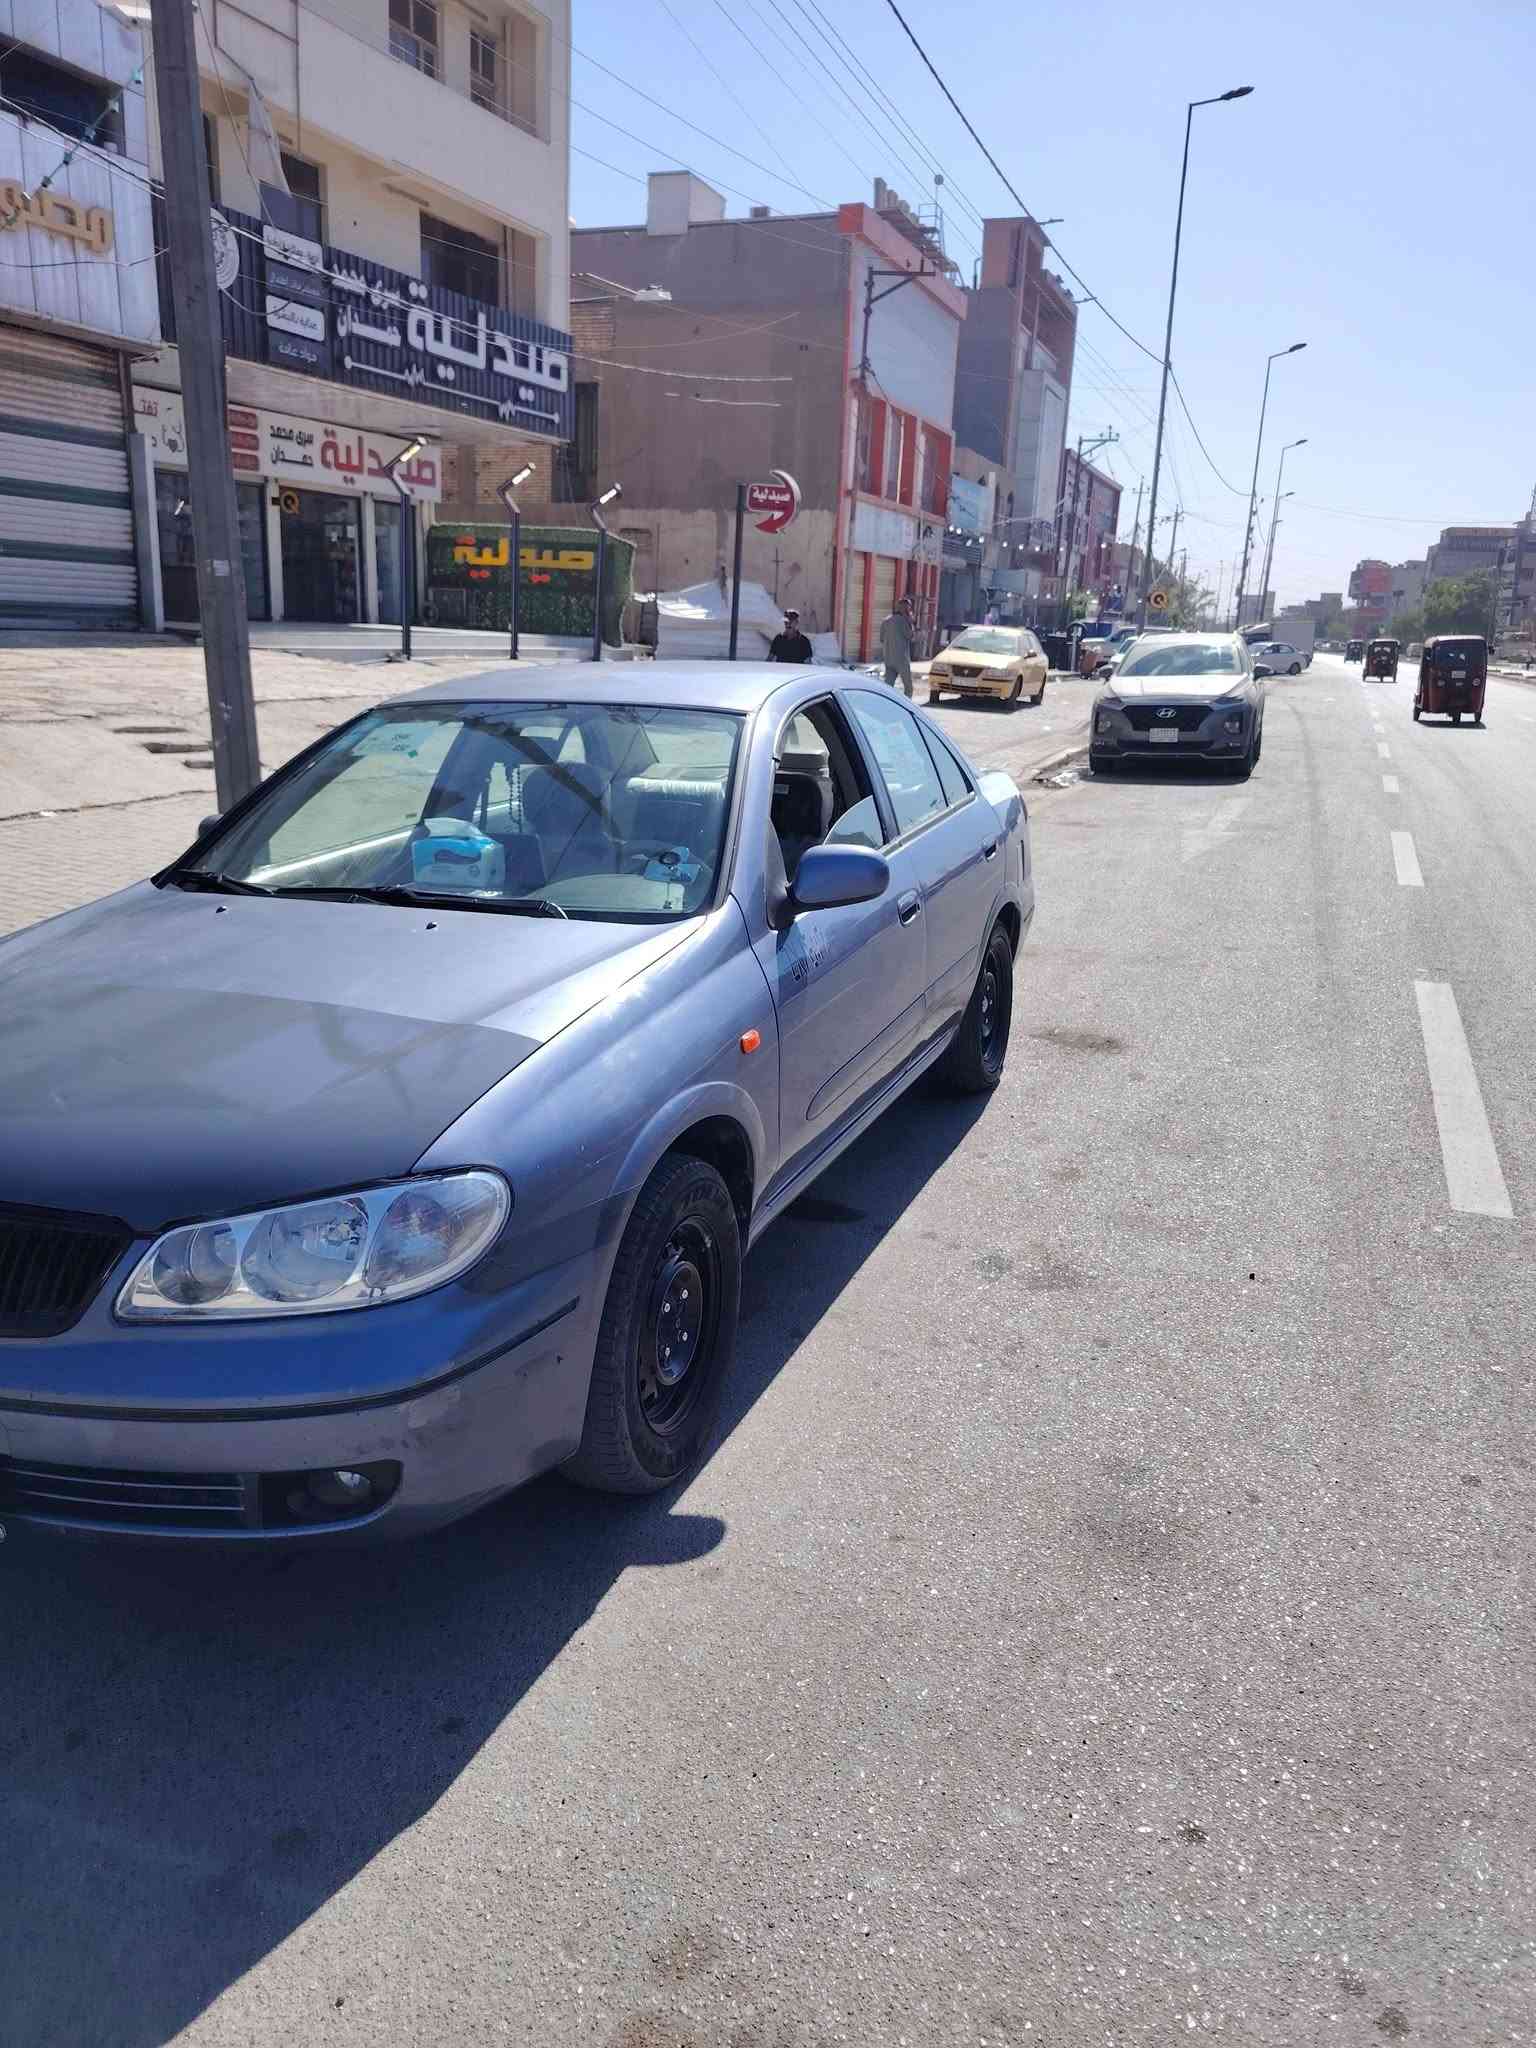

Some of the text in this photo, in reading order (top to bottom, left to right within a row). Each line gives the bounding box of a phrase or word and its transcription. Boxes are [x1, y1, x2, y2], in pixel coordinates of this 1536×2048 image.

[337, 305, 401, 347] حمدان
[407, 281, 568, 402] صيدلية
[269, 424, 294, 440] محمد
[270, 446, 315, 467] حمدان
[751, 486, 791, 504] صيدلية
[453, 535, 595, 584] صيدلية
